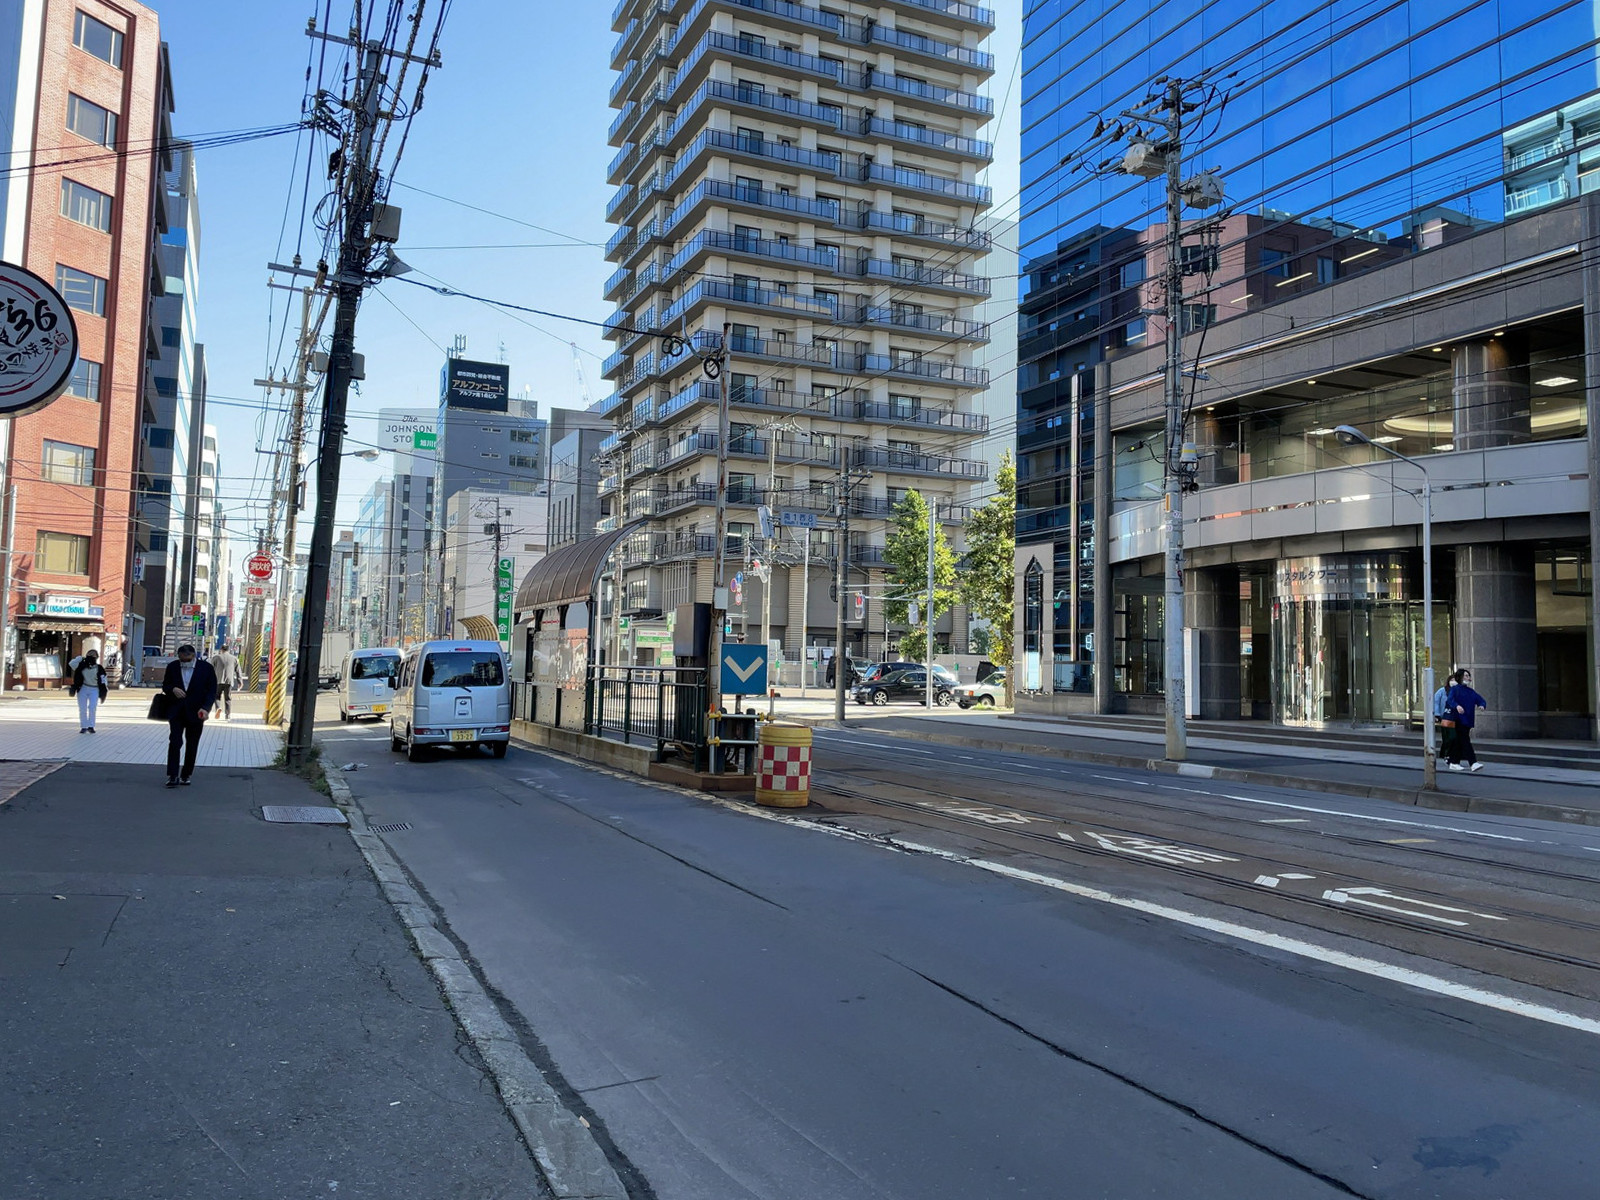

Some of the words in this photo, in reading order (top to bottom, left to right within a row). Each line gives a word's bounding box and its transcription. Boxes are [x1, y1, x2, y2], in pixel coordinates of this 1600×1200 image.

[452, 379, 505, 393] アルファコート
[402, 415, 418, 423] The
[385, 425, 433, 433] JOHNSON
[250, 561, 271, 571] 消火栓
[184, 605, 193, 615] P
